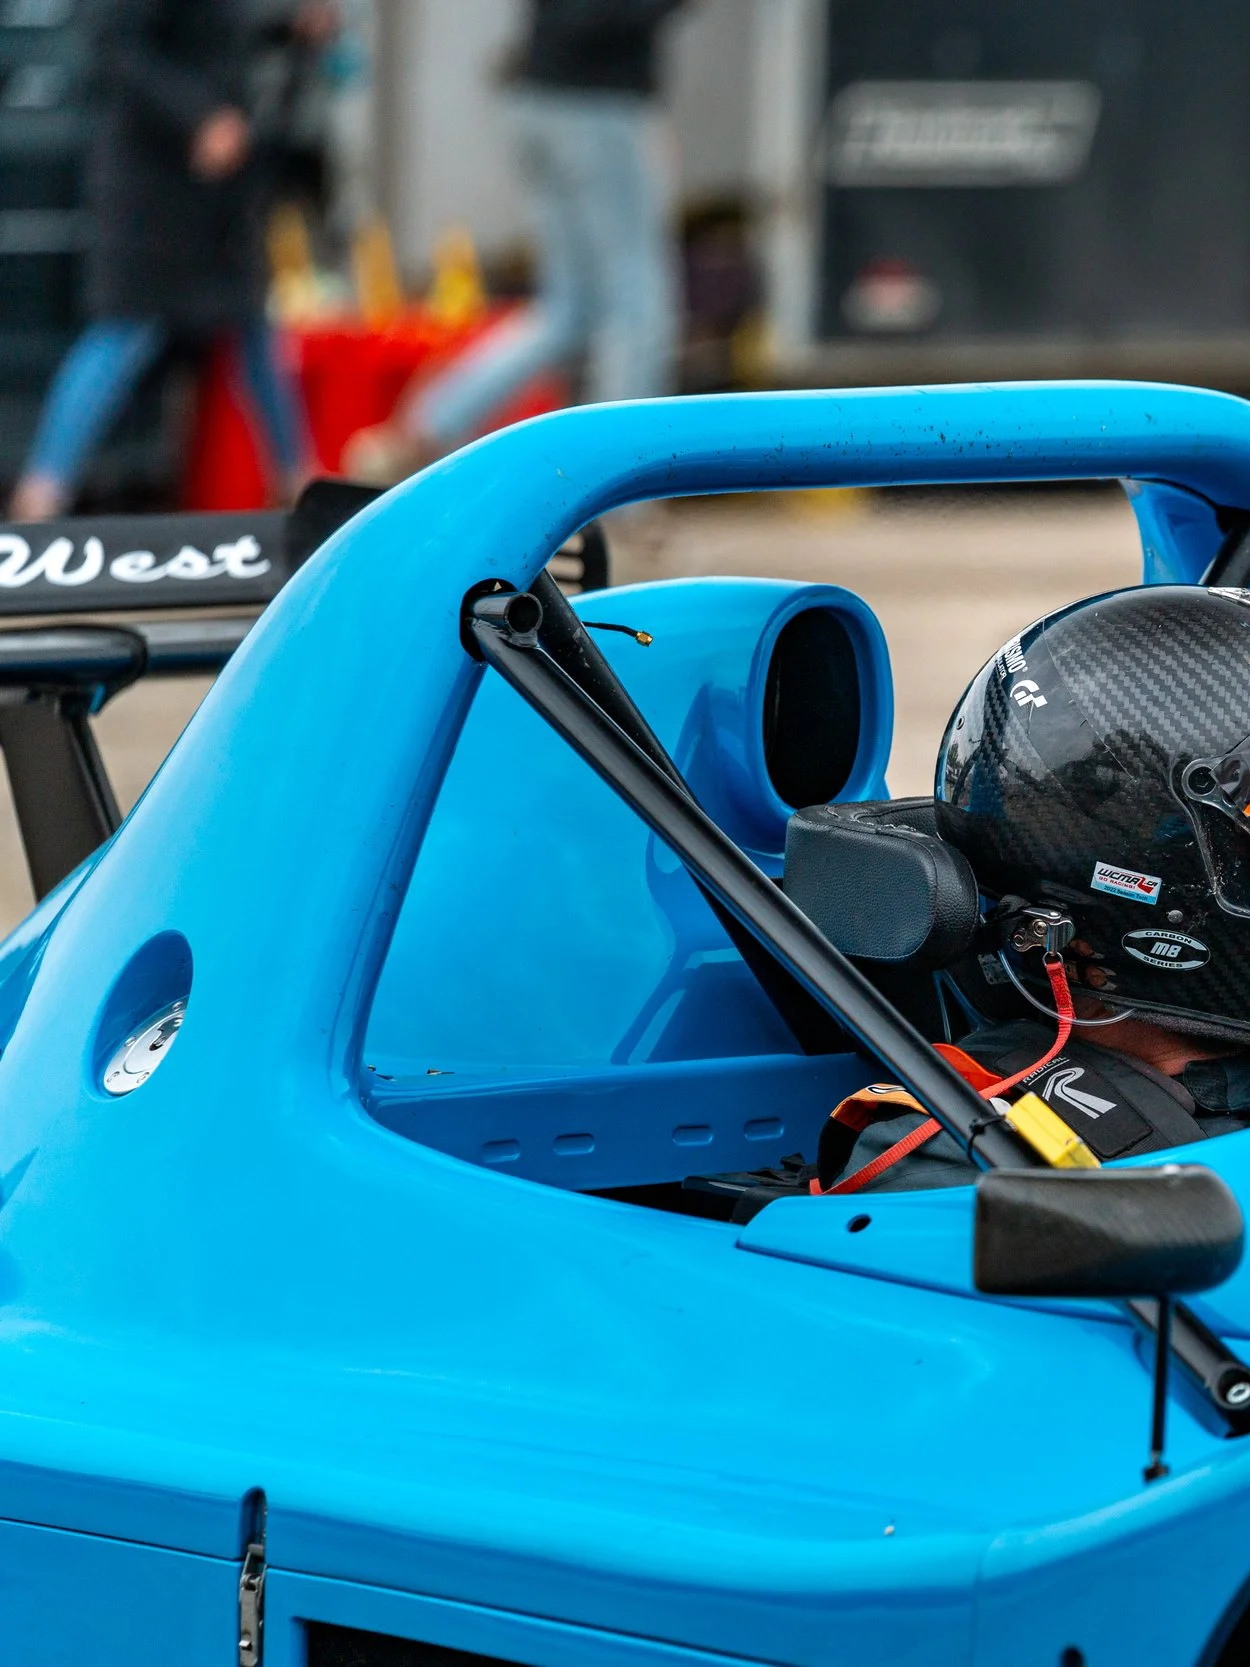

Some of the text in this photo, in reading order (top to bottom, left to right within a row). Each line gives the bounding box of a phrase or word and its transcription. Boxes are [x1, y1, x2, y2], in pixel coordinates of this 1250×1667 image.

[0, 533, 272, 588] West
[1103, 885, 1148, 901] 2022 Season Tech
[1145, 931, 1193, 945] CARBON
[1142, 956, 1183, 968] SERIES
[1021, 1055, 1068, 1084] RADICAL
